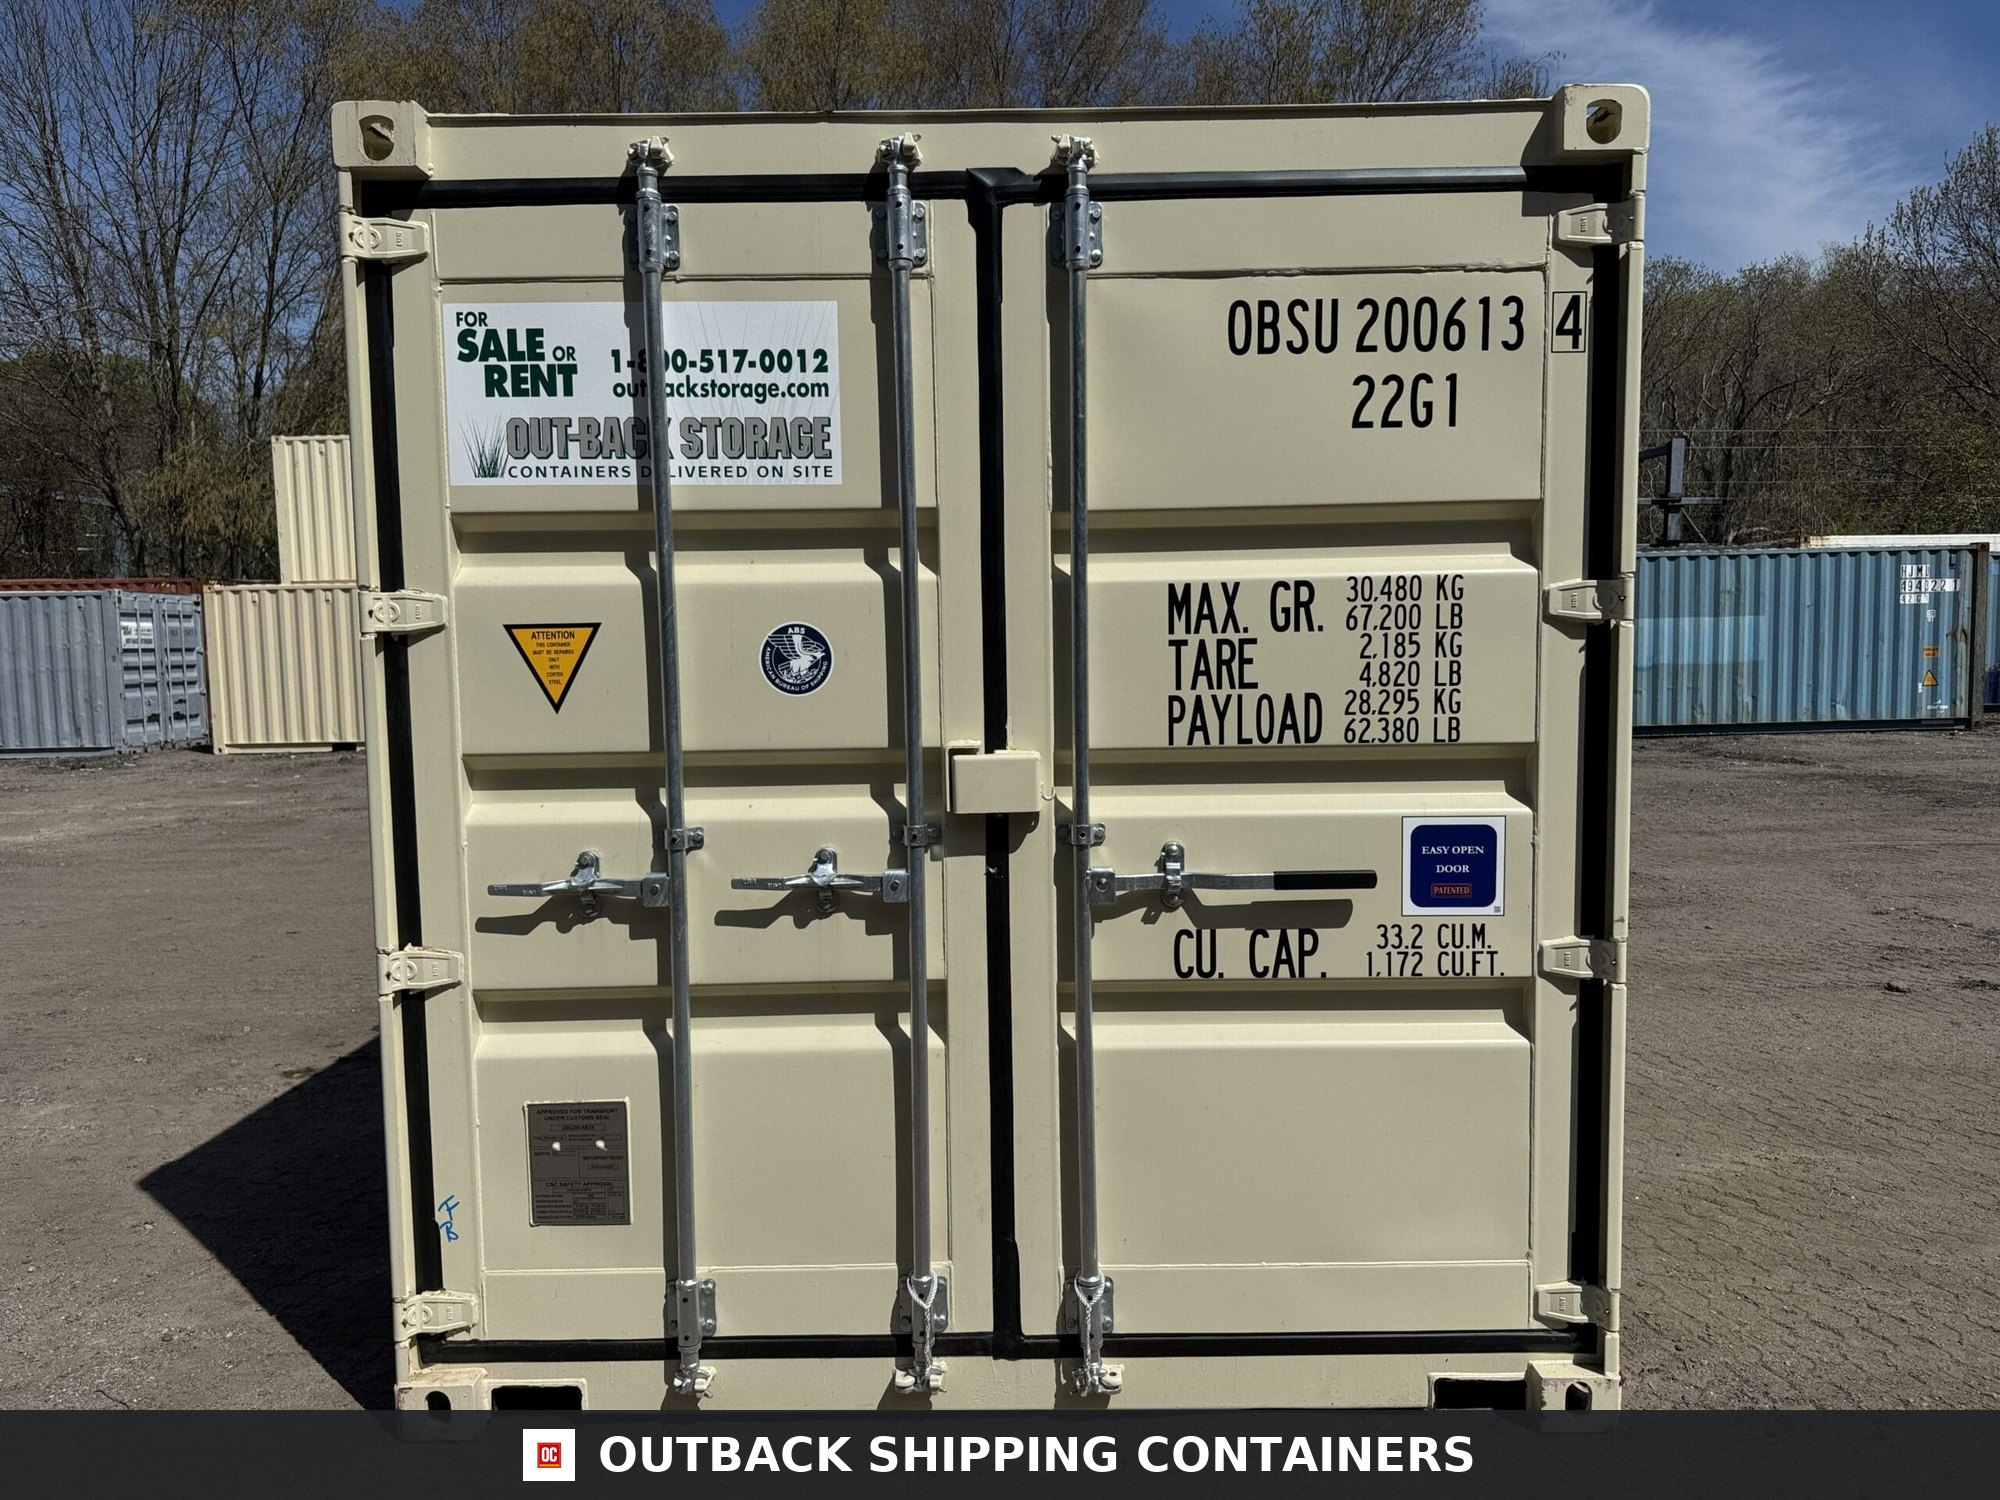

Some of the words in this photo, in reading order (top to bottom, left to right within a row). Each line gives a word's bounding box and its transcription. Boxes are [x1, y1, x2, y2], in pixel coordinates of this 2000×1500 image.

[456, 311, 489, 328] FOR
[1227, 298, 1339, 356] OBSU
[1355, 295, 1525, 353] 200613
[1555, 294, 1583, 350] 4
[457, 328, 546, 363] SALE
[552, 345, 577, 362] OR
[484, 363, 578, 398] RENT
[612, 374, 830, 405] outackstorage.com
[1351, 372, 1458, 429] 22G1
[679, 416, 832, 460] STORAGE
[508, 465, 631, 479] CONTAINERS
[757, 465, 783, 478] ON
[793, 465, 833, 478] SITE
[1168, 582, 1249, 635] MAX.
[1270, 580, 1324, 633] GR.
[1346, 575, 1422, 603] 30,480
[1436, 574, 1464, 601] KG
[1345, 604, 1422, 632] 67,200
[1435, 603, 1463, 630] LB
[531, 630, 575, 640] ATTENTION
[787, 627, 806, 635] ABS
[765, 646, 776, 680] AMERICAN
[775, 678, 800, 691] BUREAU
[810, 661, 828, 687] SHIPPING
[1168, 637, 1259, 691] TARE
[1359, 632, 1421, 660] 2,185
[1434, 632, 1463, 658] KG
[1359, 660, 1421, 688] 4,820
[1434, 660, 1462, 687] LB
[1168, 693, 1323, 746] PAYLOAD
[1344, 688, 1420, 716] 28,295
[1433, 688, 1461, 715] KG
[1343, 717, 1419, 744] 62,380
[1433, 716, 1461, 743] LB
[1421, 845, 1450, 855] EASY
[1451, 845, 1485, 855] OPEN
[1435, 864, 1470, 873] DOOR
[1434, 886, 1470, 895] PATENTED
[1173, 928, 1225, 980] CU.
[1248, 928, 1328, 980] CAP.
[1376, 923, 1423, 950] 33.2
[1437, 923, 1492, 949] CU.M.
[1366, 951, 1423, 978] 1,172
[1437, 951, 1505, 977] CU.FT.
